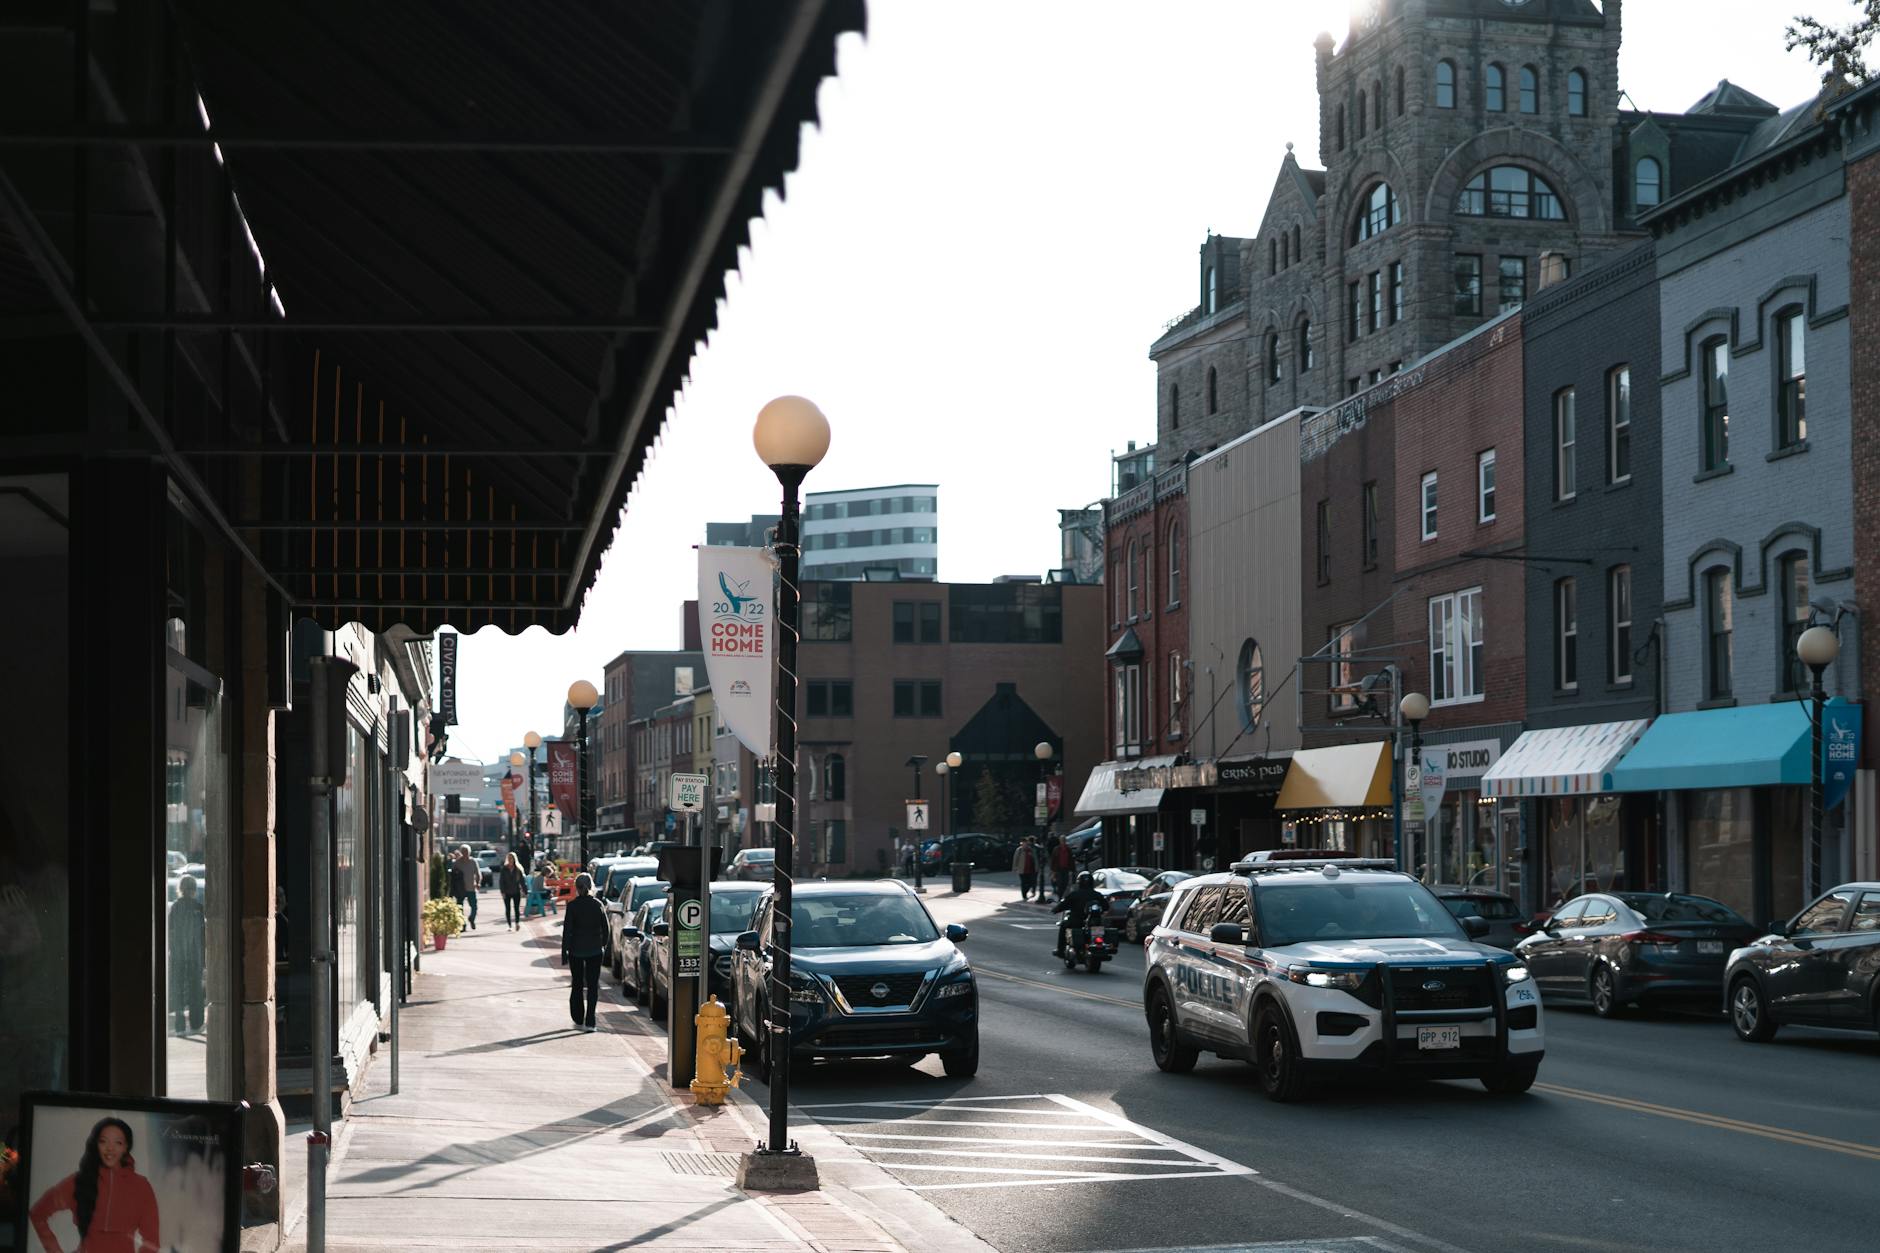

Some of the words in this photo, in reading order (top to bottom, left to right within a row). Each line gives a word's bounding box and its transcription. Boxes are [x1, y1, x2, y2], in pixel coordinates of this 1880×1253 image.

[713, 602, 729, 614] 20
[748, 603, 764, 615] 22
[711, 623, 764, 638] COME
[712, 638, 763, 653] HOME
[443, 637, 455, 675] CIVIC
[443, 689, 455, 724] DUTY
[1459, 748, 1490, 769] STUDIO
[1259, 764, 1285, 780] PUB
[681, 784, 697, 793] PAY
[677, 793, 700, 802] HERE
[1176, 963, 1232, 1004] POLICE
[1420, 1032, 1436, 1043] GPP
[1442, 1031, 1458, 1042] 912
